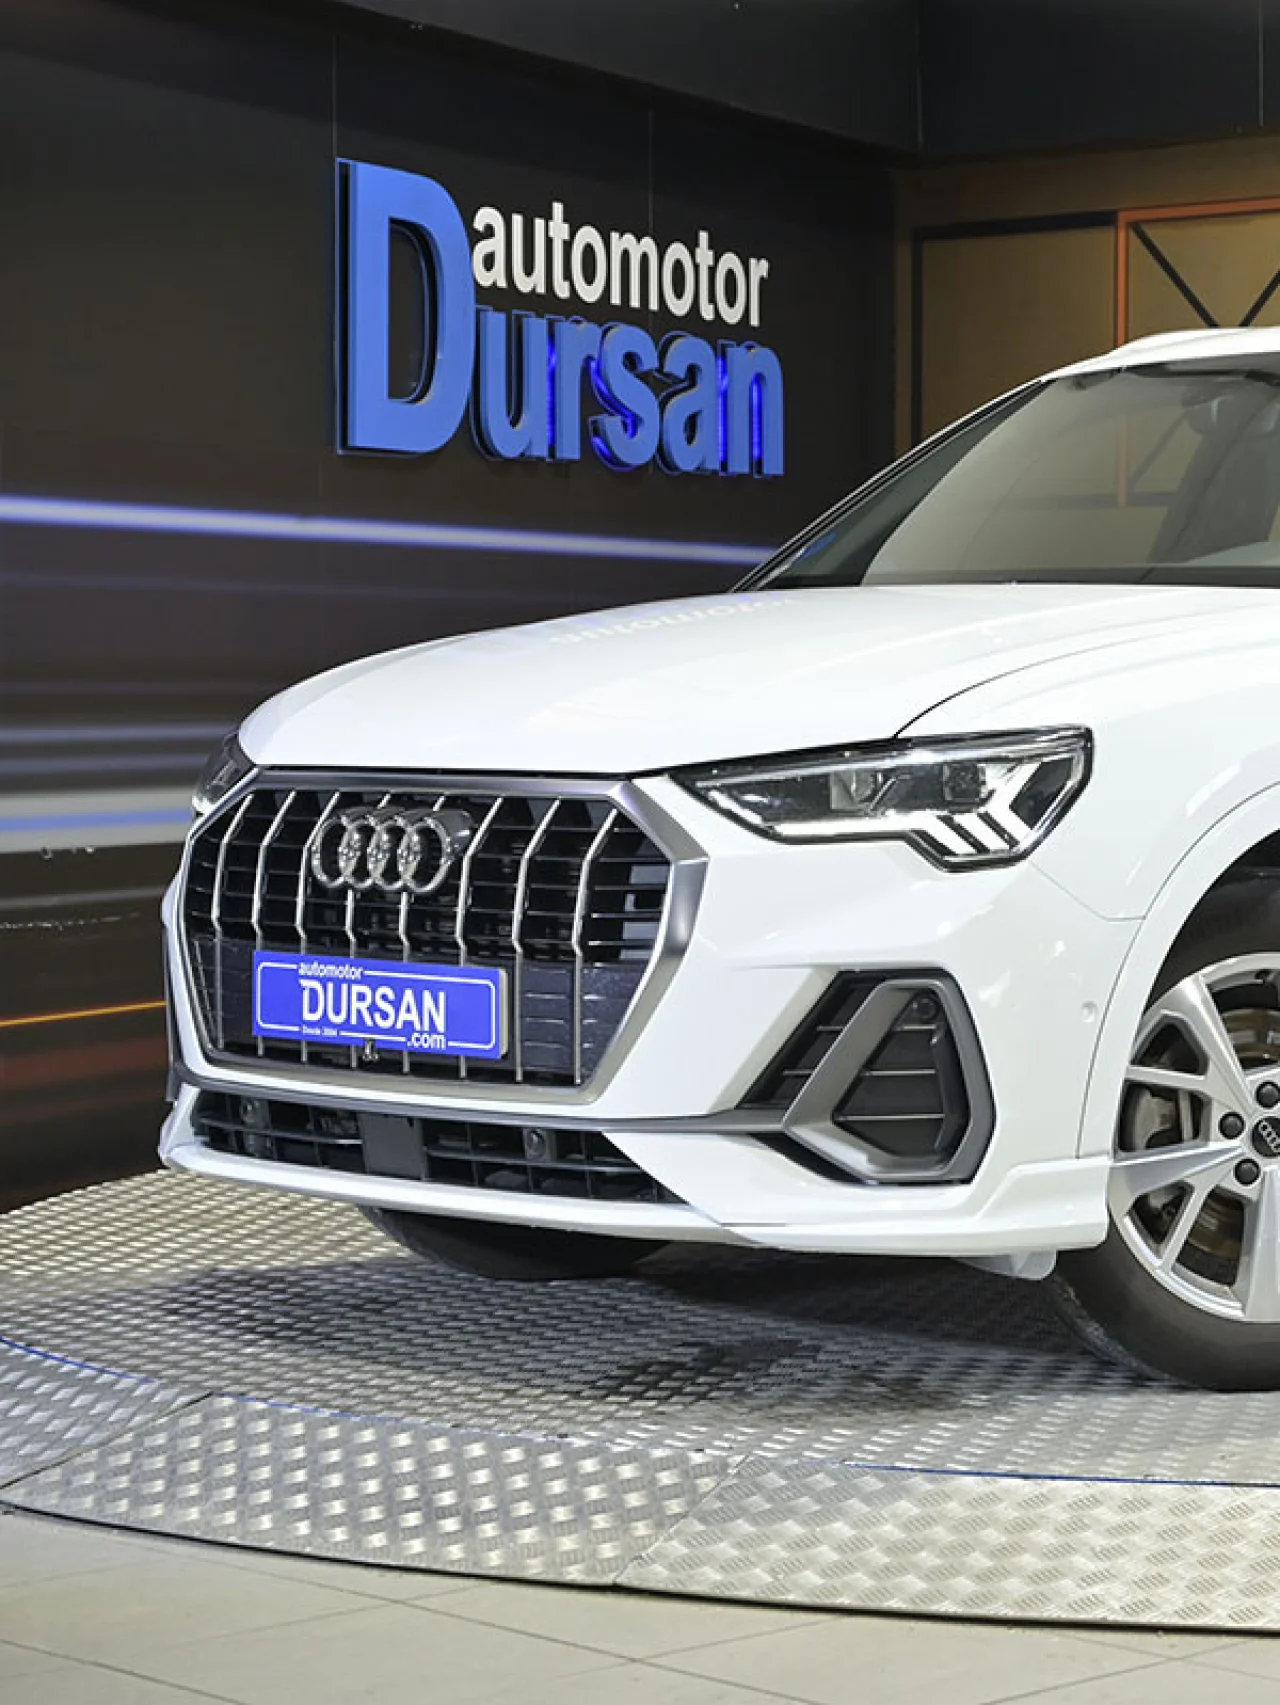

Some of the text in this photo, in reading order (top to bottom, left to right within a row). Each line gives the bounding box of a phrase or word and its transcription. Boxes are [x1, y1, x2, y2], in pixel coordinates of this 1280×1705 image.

[472, 201, 770, 328] automotor
[336, 157, 785, 479] Dursan
[299, 961, 364, 980] automotor
[299, 979, 446, 1032] DURSAN
[406, 1032, 447, 1049] .com
